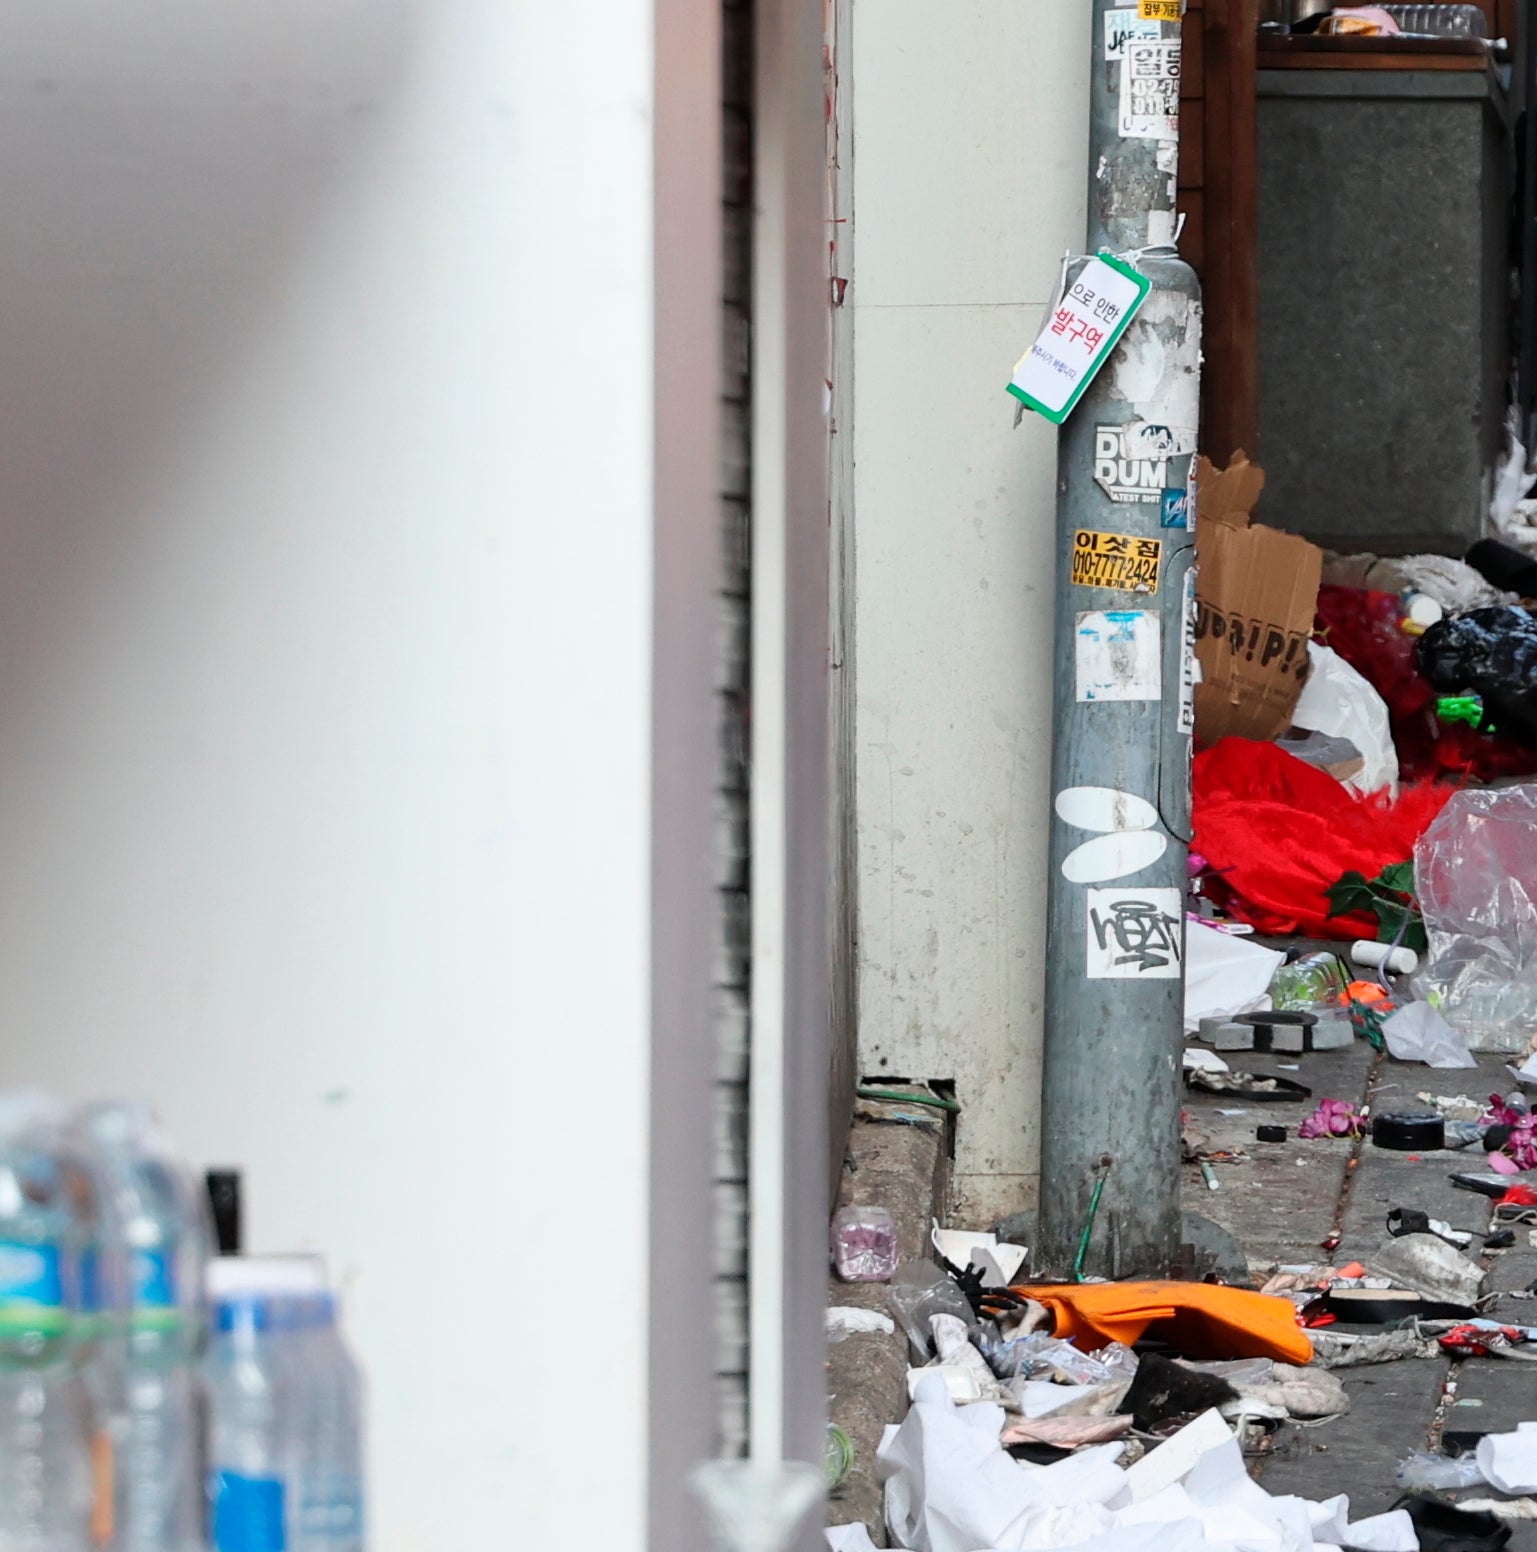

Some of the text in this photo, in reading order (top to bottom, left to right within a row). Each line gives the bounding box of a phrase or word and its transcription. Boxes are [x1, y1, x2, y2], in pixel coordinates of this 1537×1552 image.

[1093, 298, 1120, 324] 인한
[1096, 459, 1166, 488] DUM
[1142, 494, 1160, 504] SHIT
[1076, 531, 1160, 558] 이삿짐
